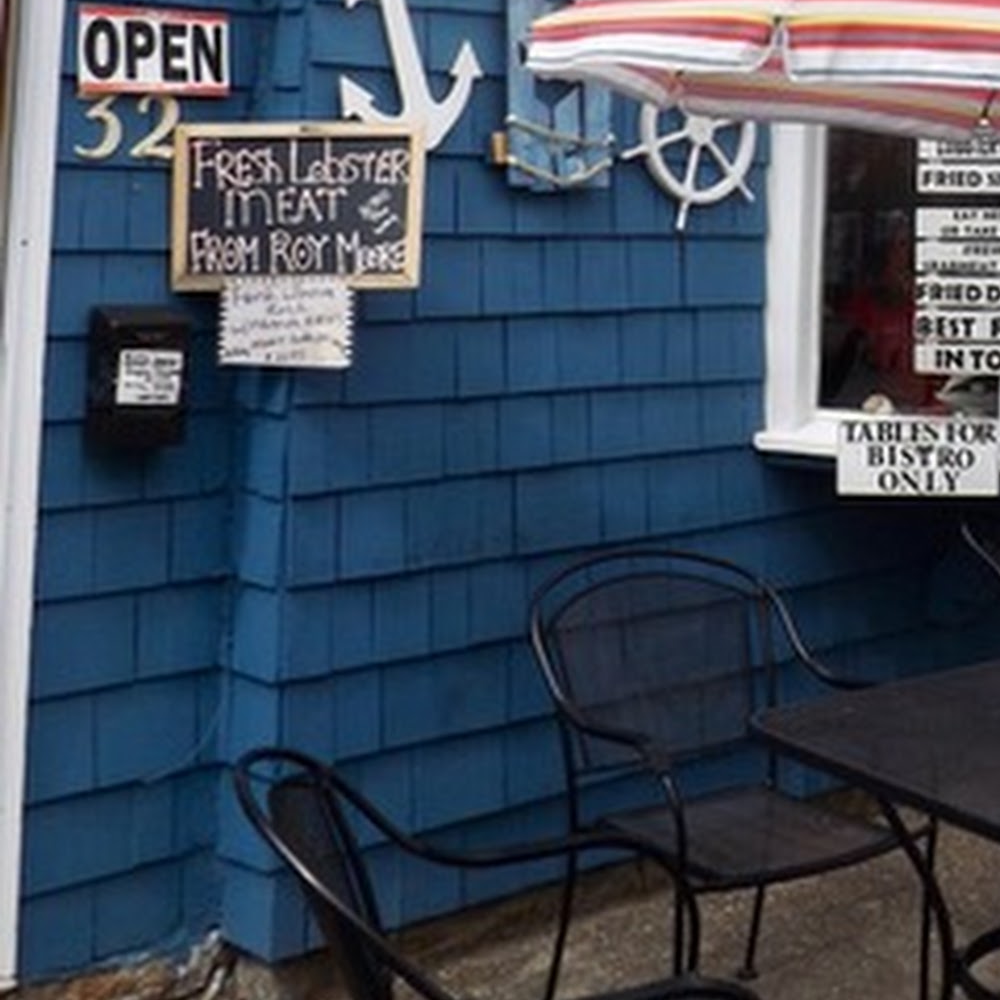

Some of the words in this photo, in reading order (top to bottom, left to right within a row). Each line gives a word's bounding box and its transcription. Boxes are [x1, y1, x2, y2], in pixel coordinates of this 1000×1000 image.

[84, 16, 223, 84] OPEN
[73, 94, 175, 159] 32
[922, 169, 983, 188] FRIED
[269, 228, 330, 275] ROY
[916, 283, 983, 302] FRIED
[917, 315, 976, 338] BEST
[935, 348, 964, 370] IN
[841, 420, 940, 444] TABLES
[945, 421, 998, 446] FOR
[866, 444, 976, 470] BISTRO
[876, 469, 961, 495] ONLY
